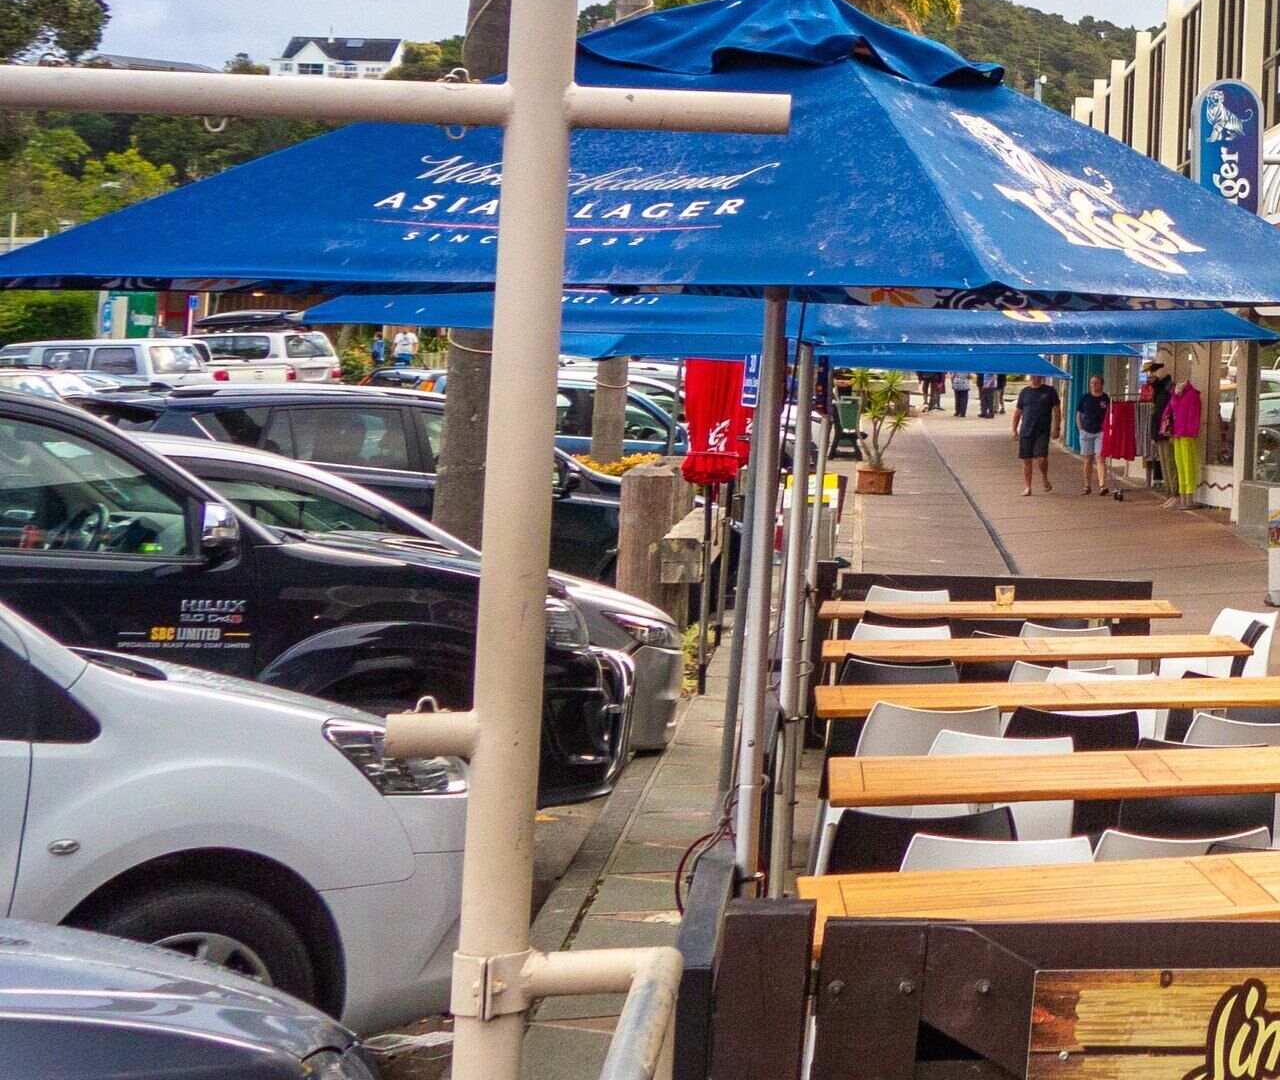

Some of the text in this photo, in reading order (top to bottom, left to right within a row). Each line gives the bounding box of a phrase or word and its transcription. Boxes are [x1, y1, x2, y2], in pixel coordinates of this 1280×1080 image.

[373, 191, 746, 220] ASIA LAGER
[993, 183, 1207, 275] Tiger
[402, 231, 498, 245] SINC
[180, 599, 248, 612] HILUX
[151, 626, 221, 641] SBC LIMITED
